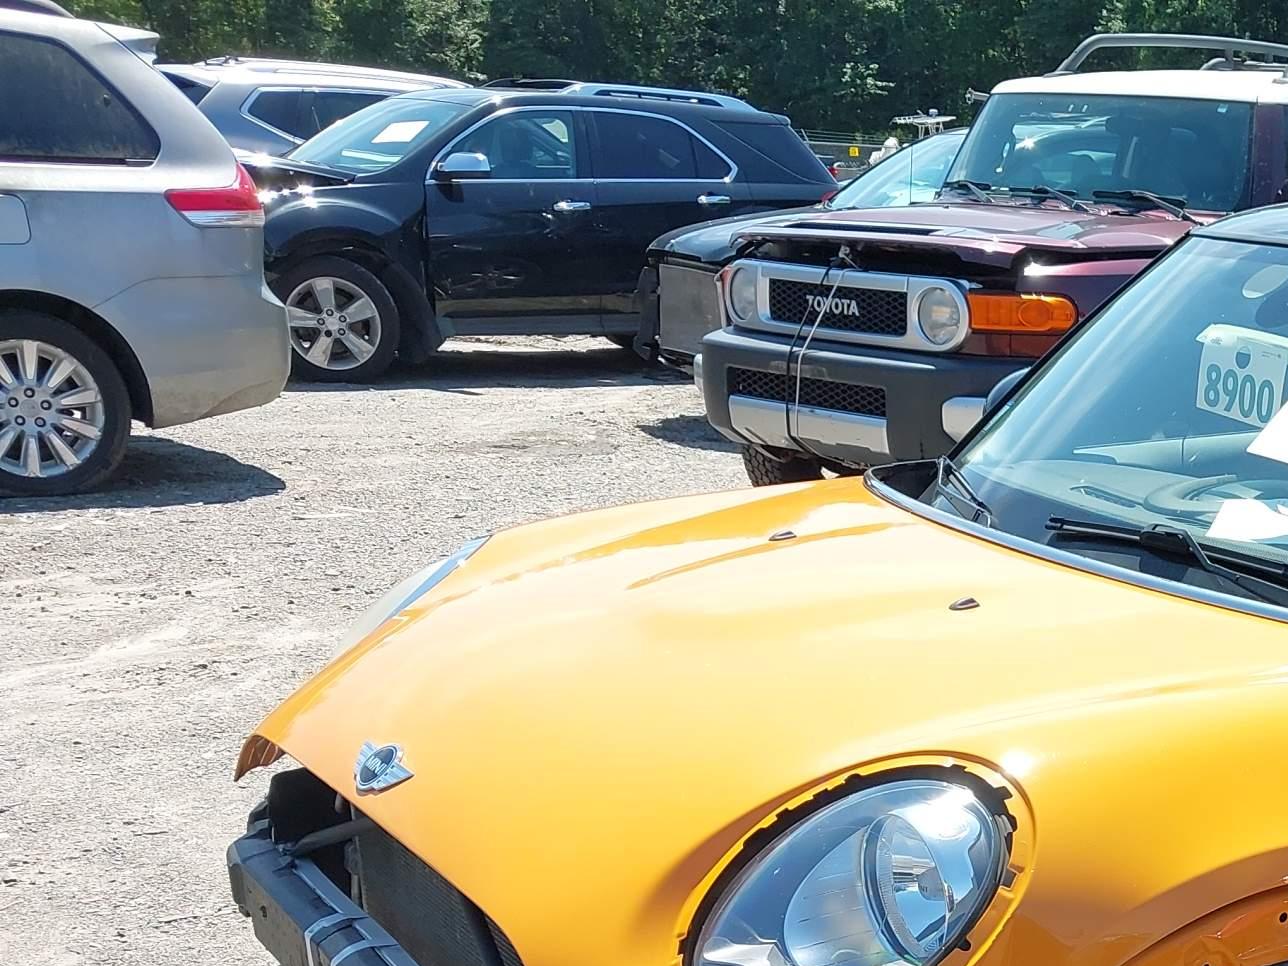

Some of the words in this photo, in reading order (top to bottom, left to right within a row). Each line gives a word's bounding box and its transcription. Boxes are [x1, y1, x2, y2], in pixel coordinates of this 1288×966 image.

[805, 294, 860, 317] TOYOTA
[1203, 362, 1275, 424] 8900
[364, 755, 388, 776] MINI
